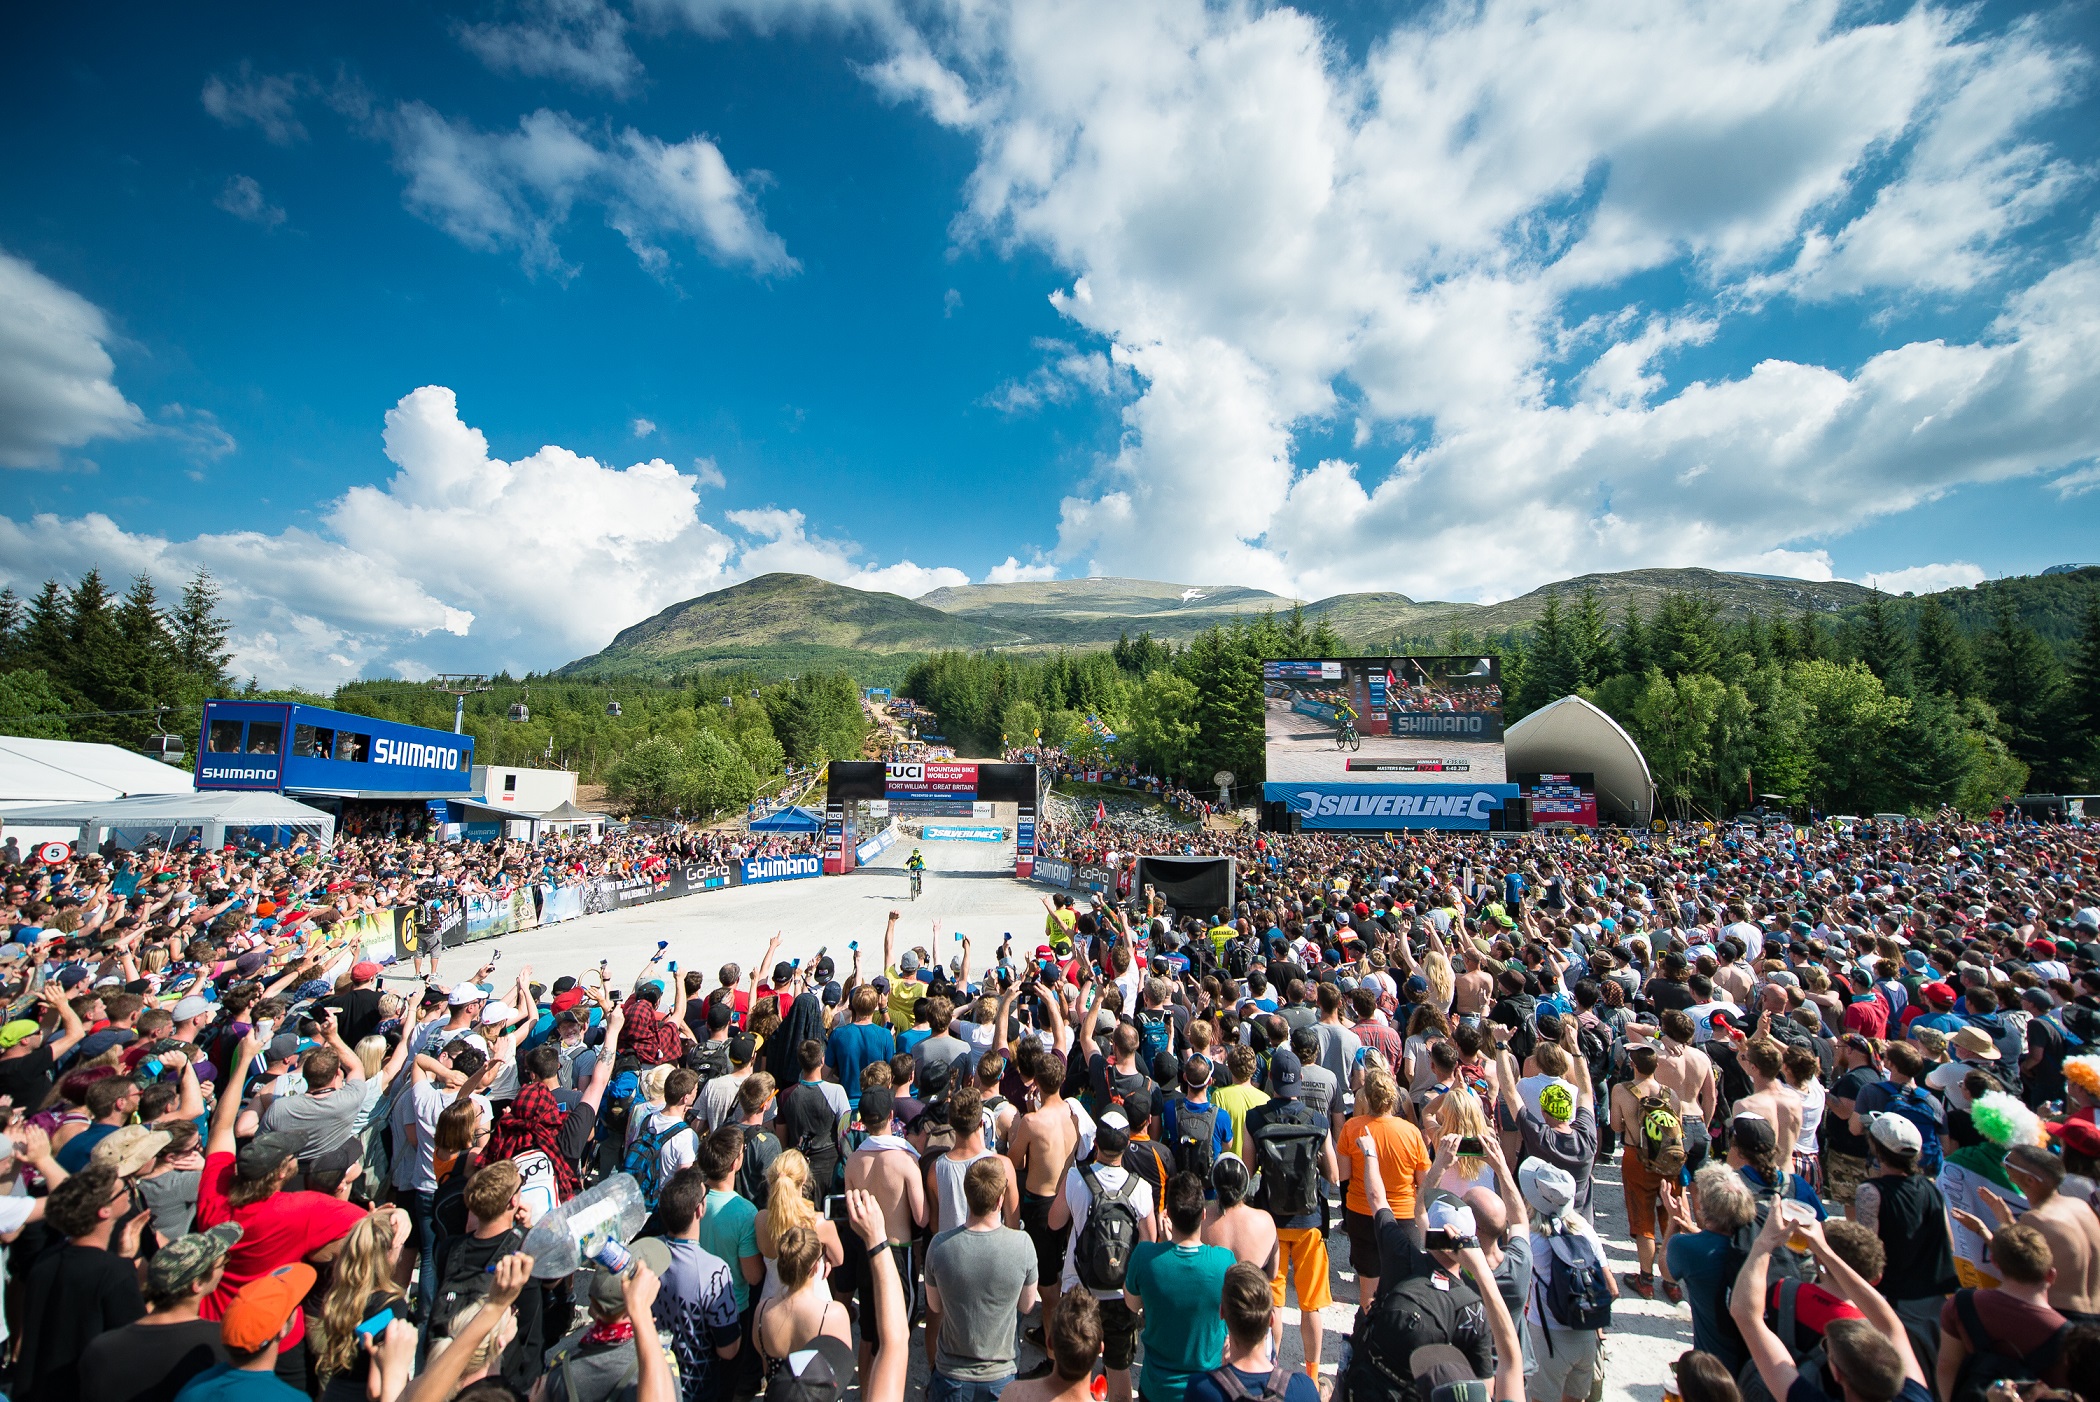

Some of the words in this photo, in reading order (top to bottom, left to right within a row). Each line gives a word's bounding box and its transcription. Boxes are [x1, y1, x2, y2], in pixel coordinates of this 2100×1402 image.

[1398, 716, 1483, 733] SHIMANO
[374, 738, 458, 771] SHIMANO
[202, 767, 277, 780] SHIMANO
[892, 766, 922, 778] UCI
[51, 848, 60, 857] 5
[686, 865, 730, 882] GoPro
[748, 857, 818, 879] SHIMANO
[1034, 861, 1069, 882] SHIMANO
[1080, 867, 1109, 883] GoPro
[1301, 1081, 1325, 1089] NDICATE
